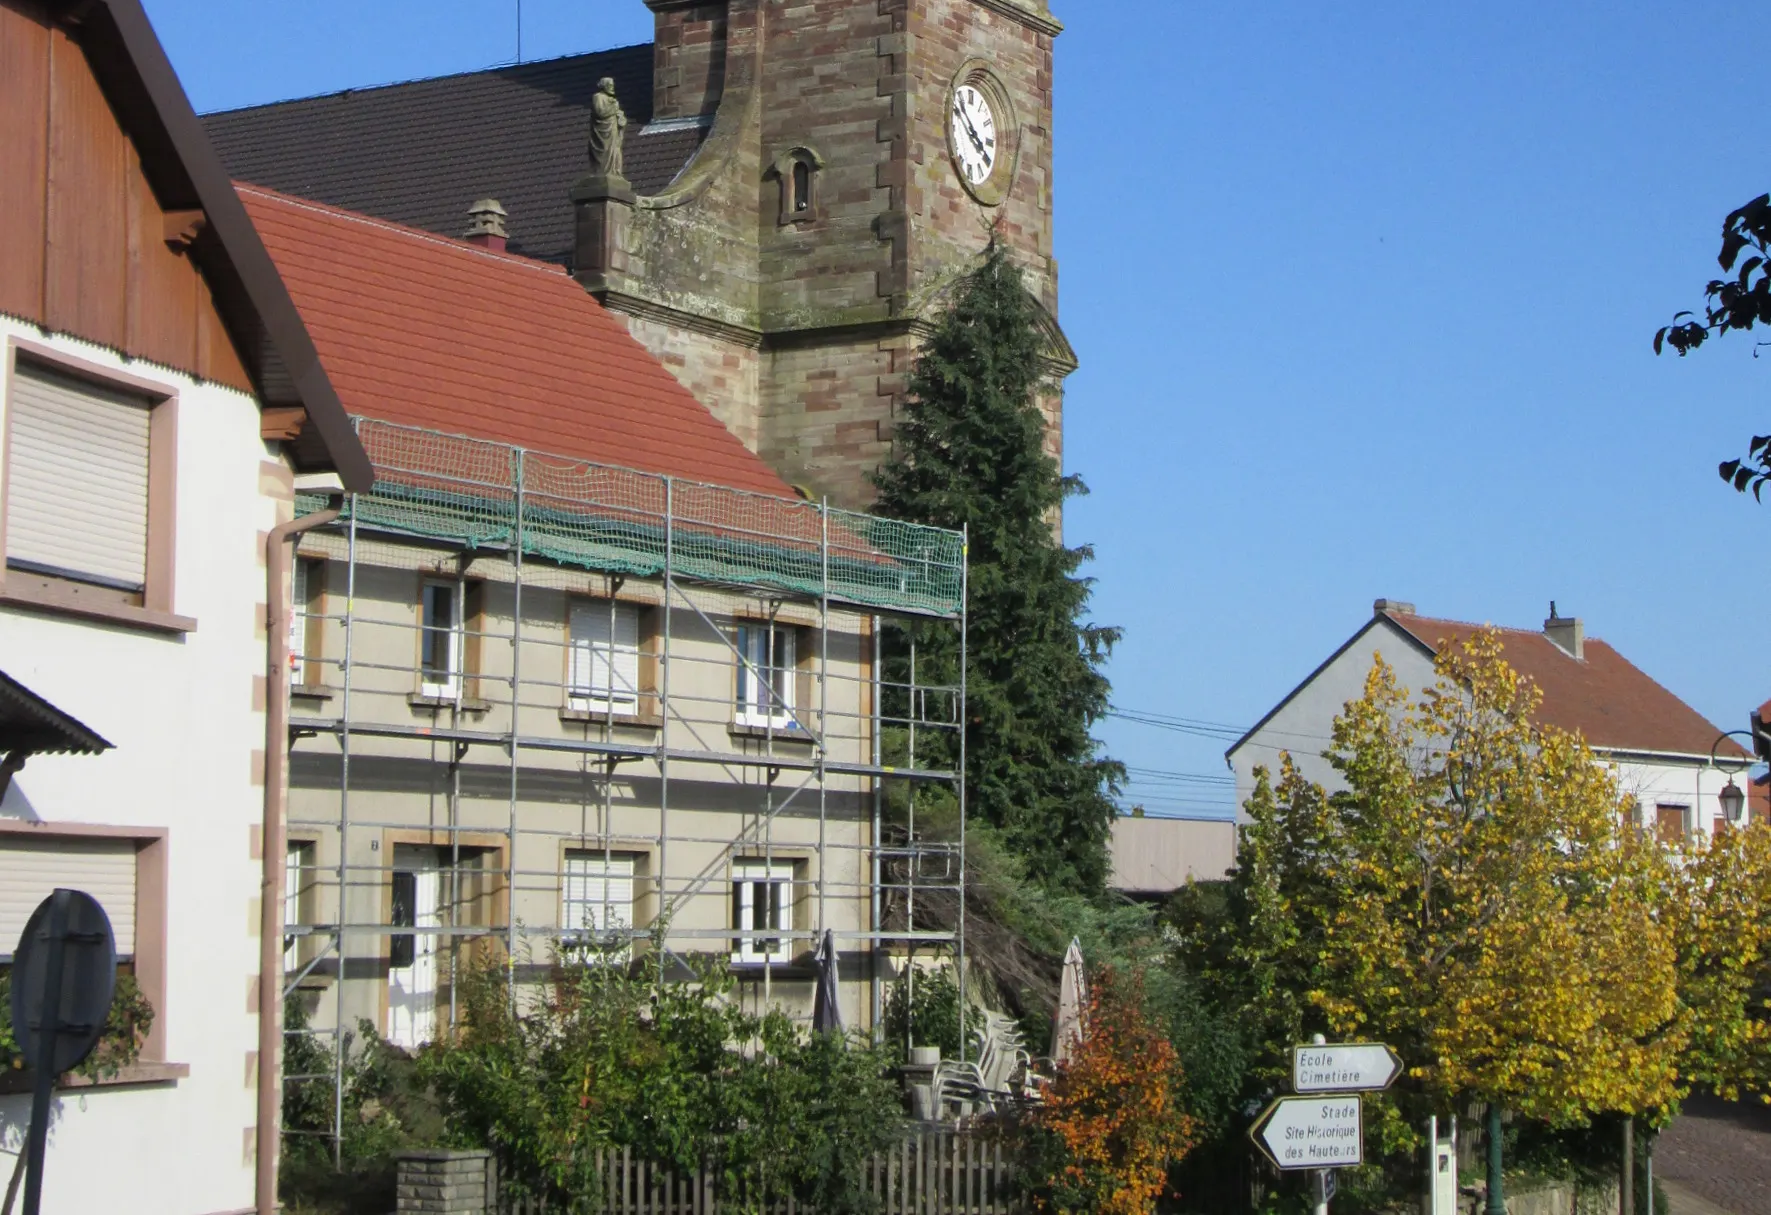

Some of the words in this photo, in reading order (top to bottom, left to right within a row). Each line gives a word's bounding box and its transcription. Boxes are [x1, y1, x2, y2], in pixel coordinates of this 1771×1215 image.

[1300, 1050, 1333, 1067] École
[1300, 1069, 1360, 1084] Cimetière
[1321, 1104, 1355, 1119] Stade
[1285, 1125, 1305, 1140] Site
[1285, 1145, 1304, 1159] des
